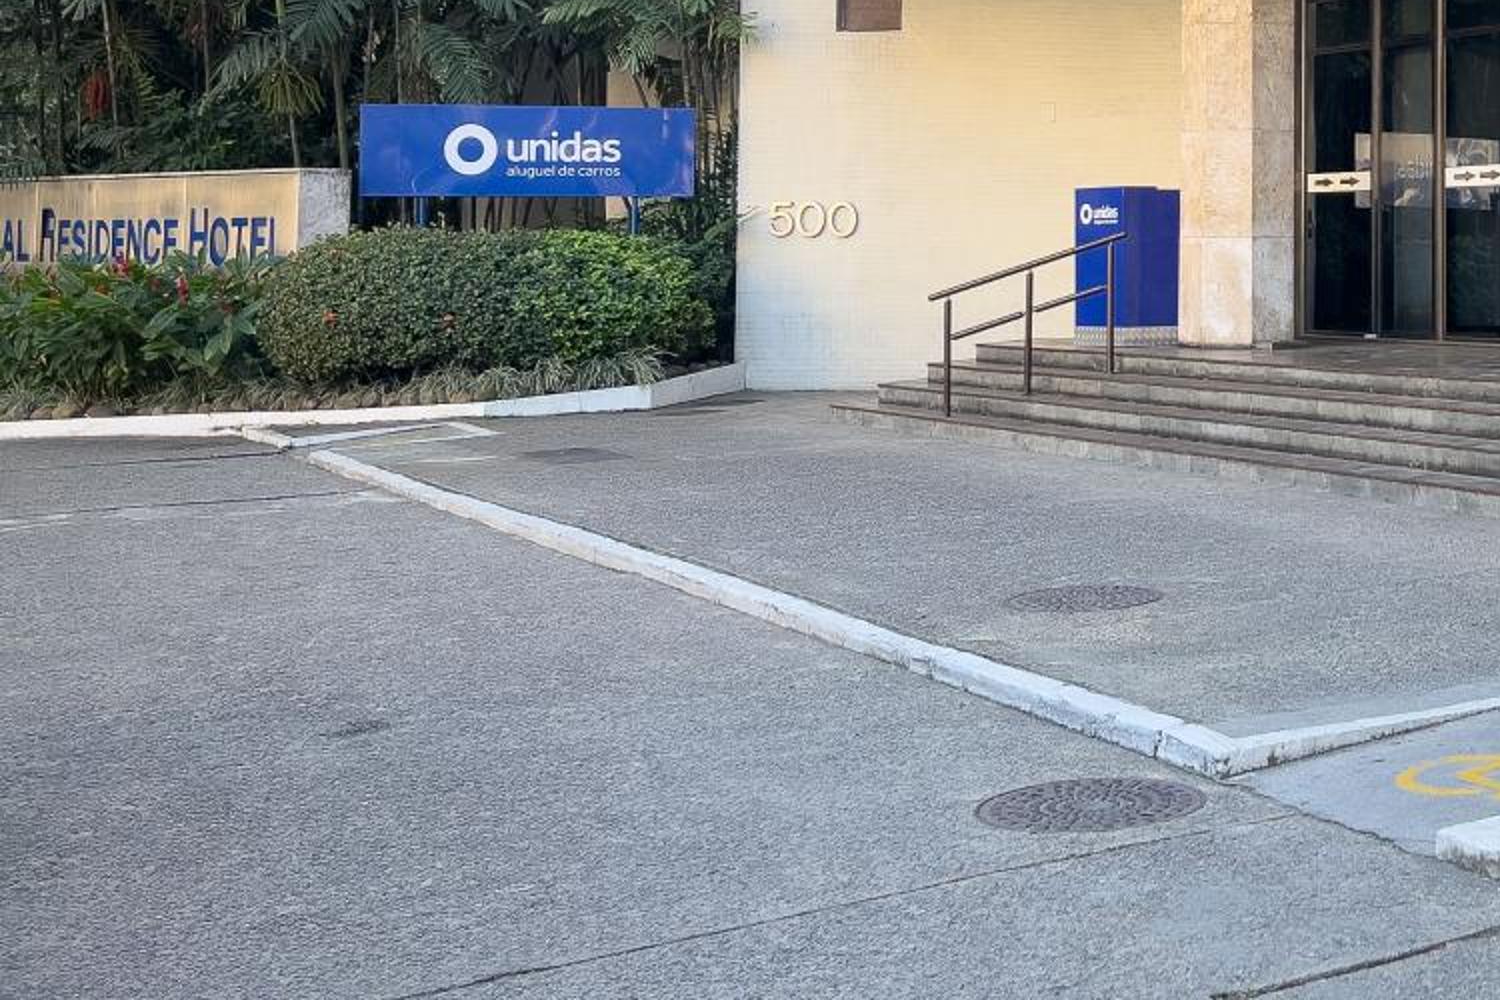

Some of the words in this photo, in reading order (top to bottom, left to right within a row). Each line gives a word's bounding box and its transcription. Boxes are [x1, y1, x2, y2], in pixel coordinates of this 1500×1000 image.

[506, 131, 622, 164] unidas
[506, 165, 554, 179] aluguel
[557, 165, 575, 178] de
[577, 167, 621, 178] carros
[40, 208, 179, 264] RESIDENCE
[189, 207, 276, 266] HOTEL
[768, 200, 859, 239] 500
